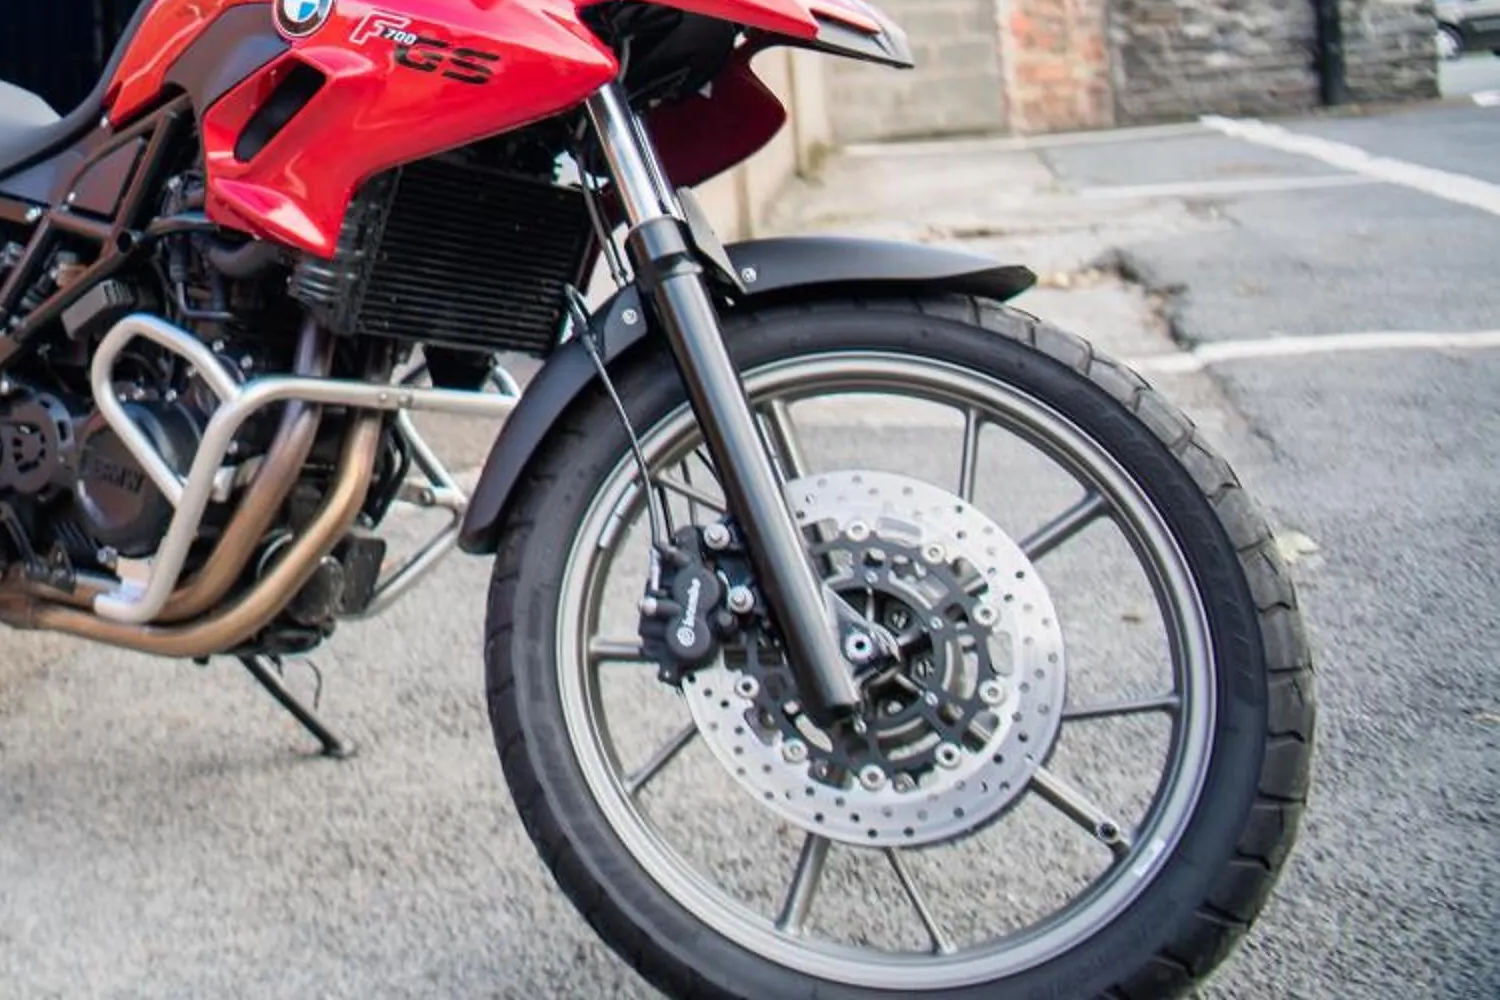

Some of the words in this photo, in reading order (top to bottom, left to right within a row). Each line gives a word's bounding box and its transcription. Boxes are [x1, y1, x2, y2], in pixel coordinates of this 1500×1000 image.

[350, 10, 412, 45] F
[385, 28, 417, 46] 700
[394, 36, 500, 85] GS
